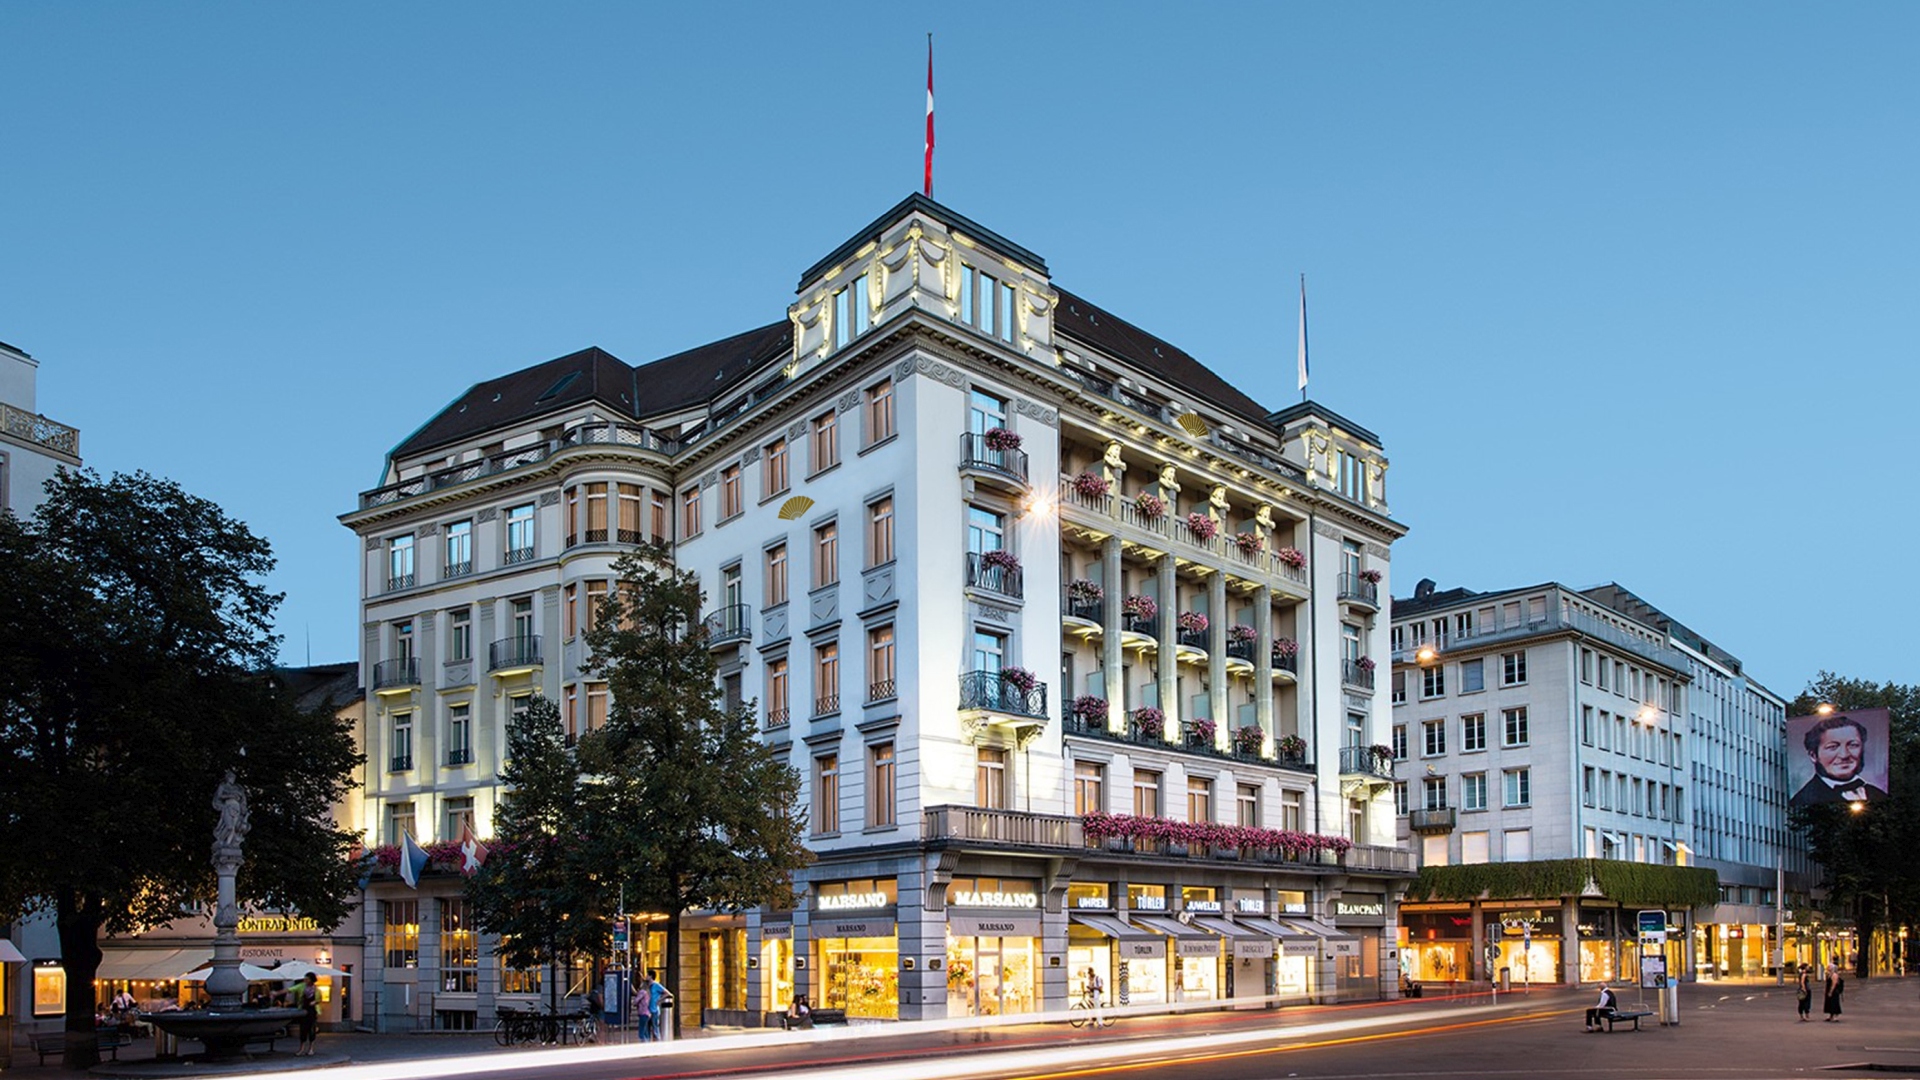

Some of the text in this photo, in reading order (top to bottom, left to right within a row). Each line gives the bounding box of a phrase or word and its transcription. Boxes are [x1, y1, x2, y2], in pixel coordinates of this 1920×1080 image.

[818, 892, 888, 910] MARSANO
[955, 891, 1038, 908] MARSANO
[1078, 897, 1109, 909] UHREN
[1136, 895, 1165, 910] TÜRLER
[1337, 902, 1383, 915] BLANCPAIN
[763, 926, 790, 935] MARSANO
[836, 923, 867, 932] MARSANO
[978, 923, 1015, 931] MARSANO
[242, 949, 283, 958] RISTORANTE
